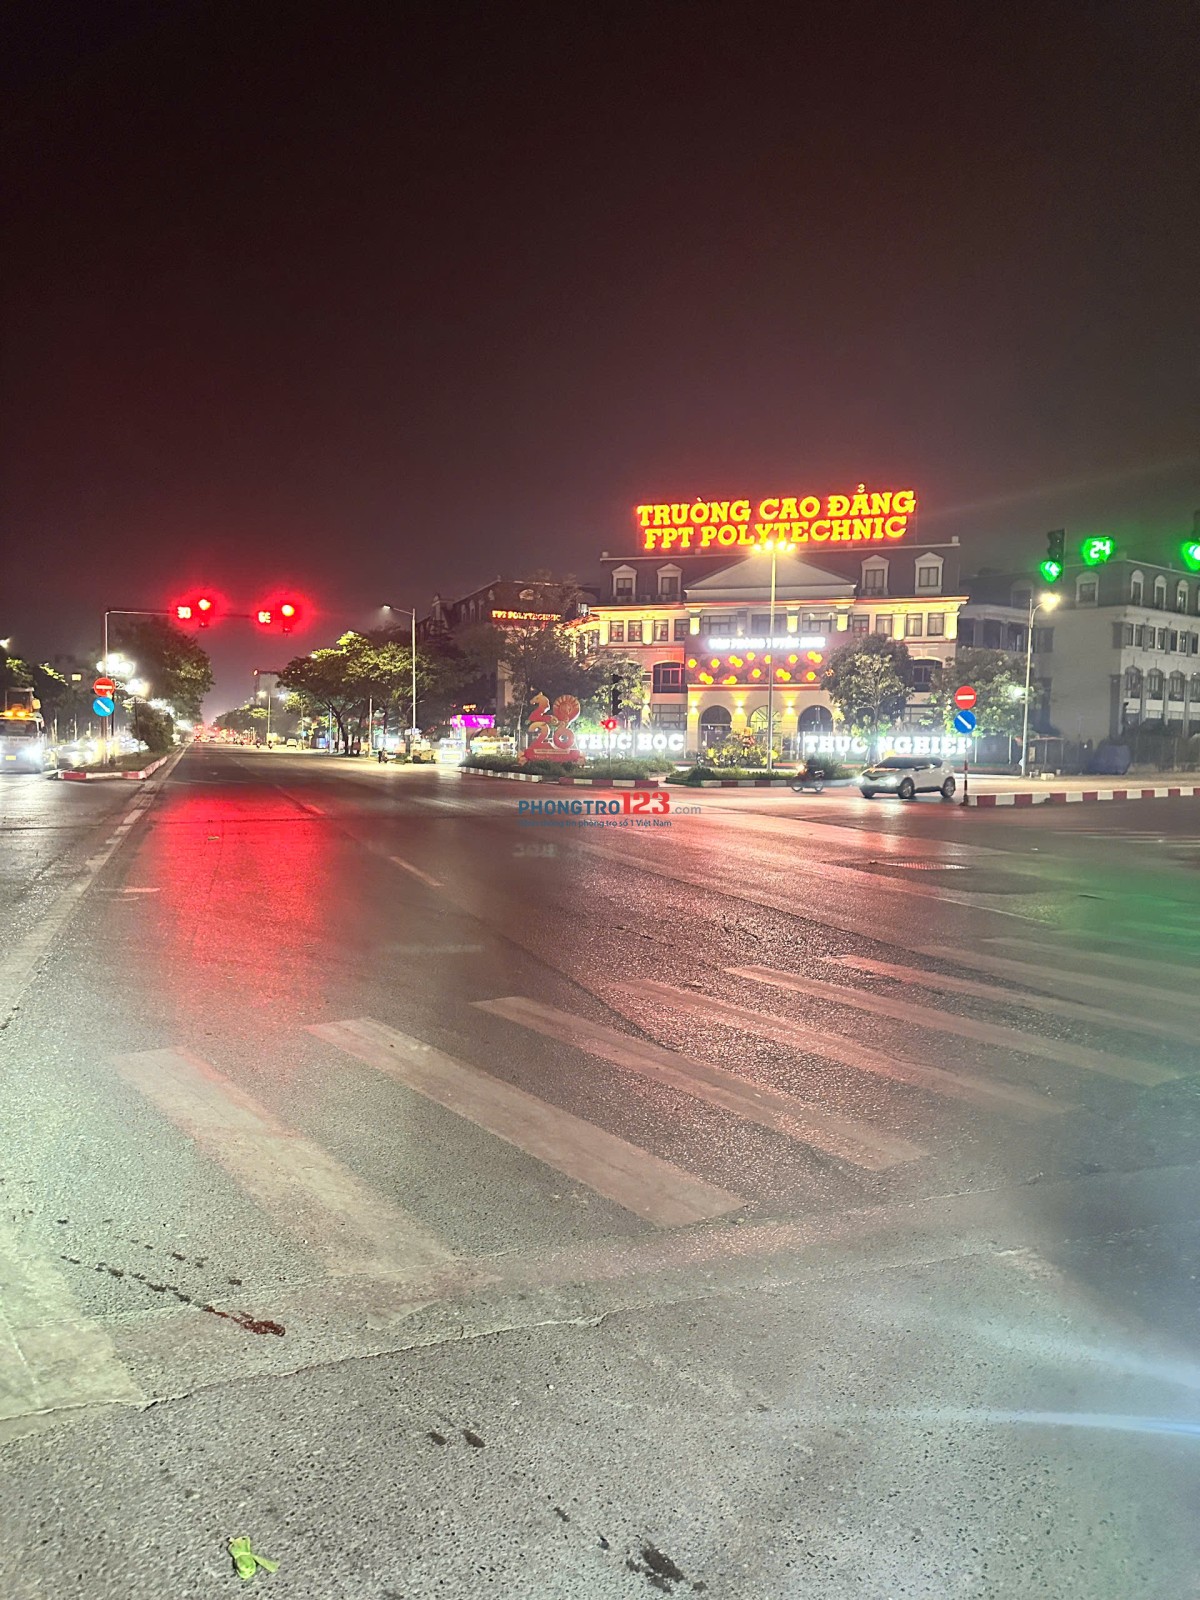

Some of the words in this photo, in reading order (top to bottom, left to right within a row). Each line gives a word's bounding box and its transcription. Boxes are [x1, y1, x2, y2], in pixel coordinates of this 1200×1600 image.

[759, 496, 820, 520] CAO
[827, 484, 916, 517] ĐẢNG
[644, 527, 694, 549] FPT
[701, 516, 907, 546] POLYTECHNIC
[1090, 541, 1111, 558] 24
